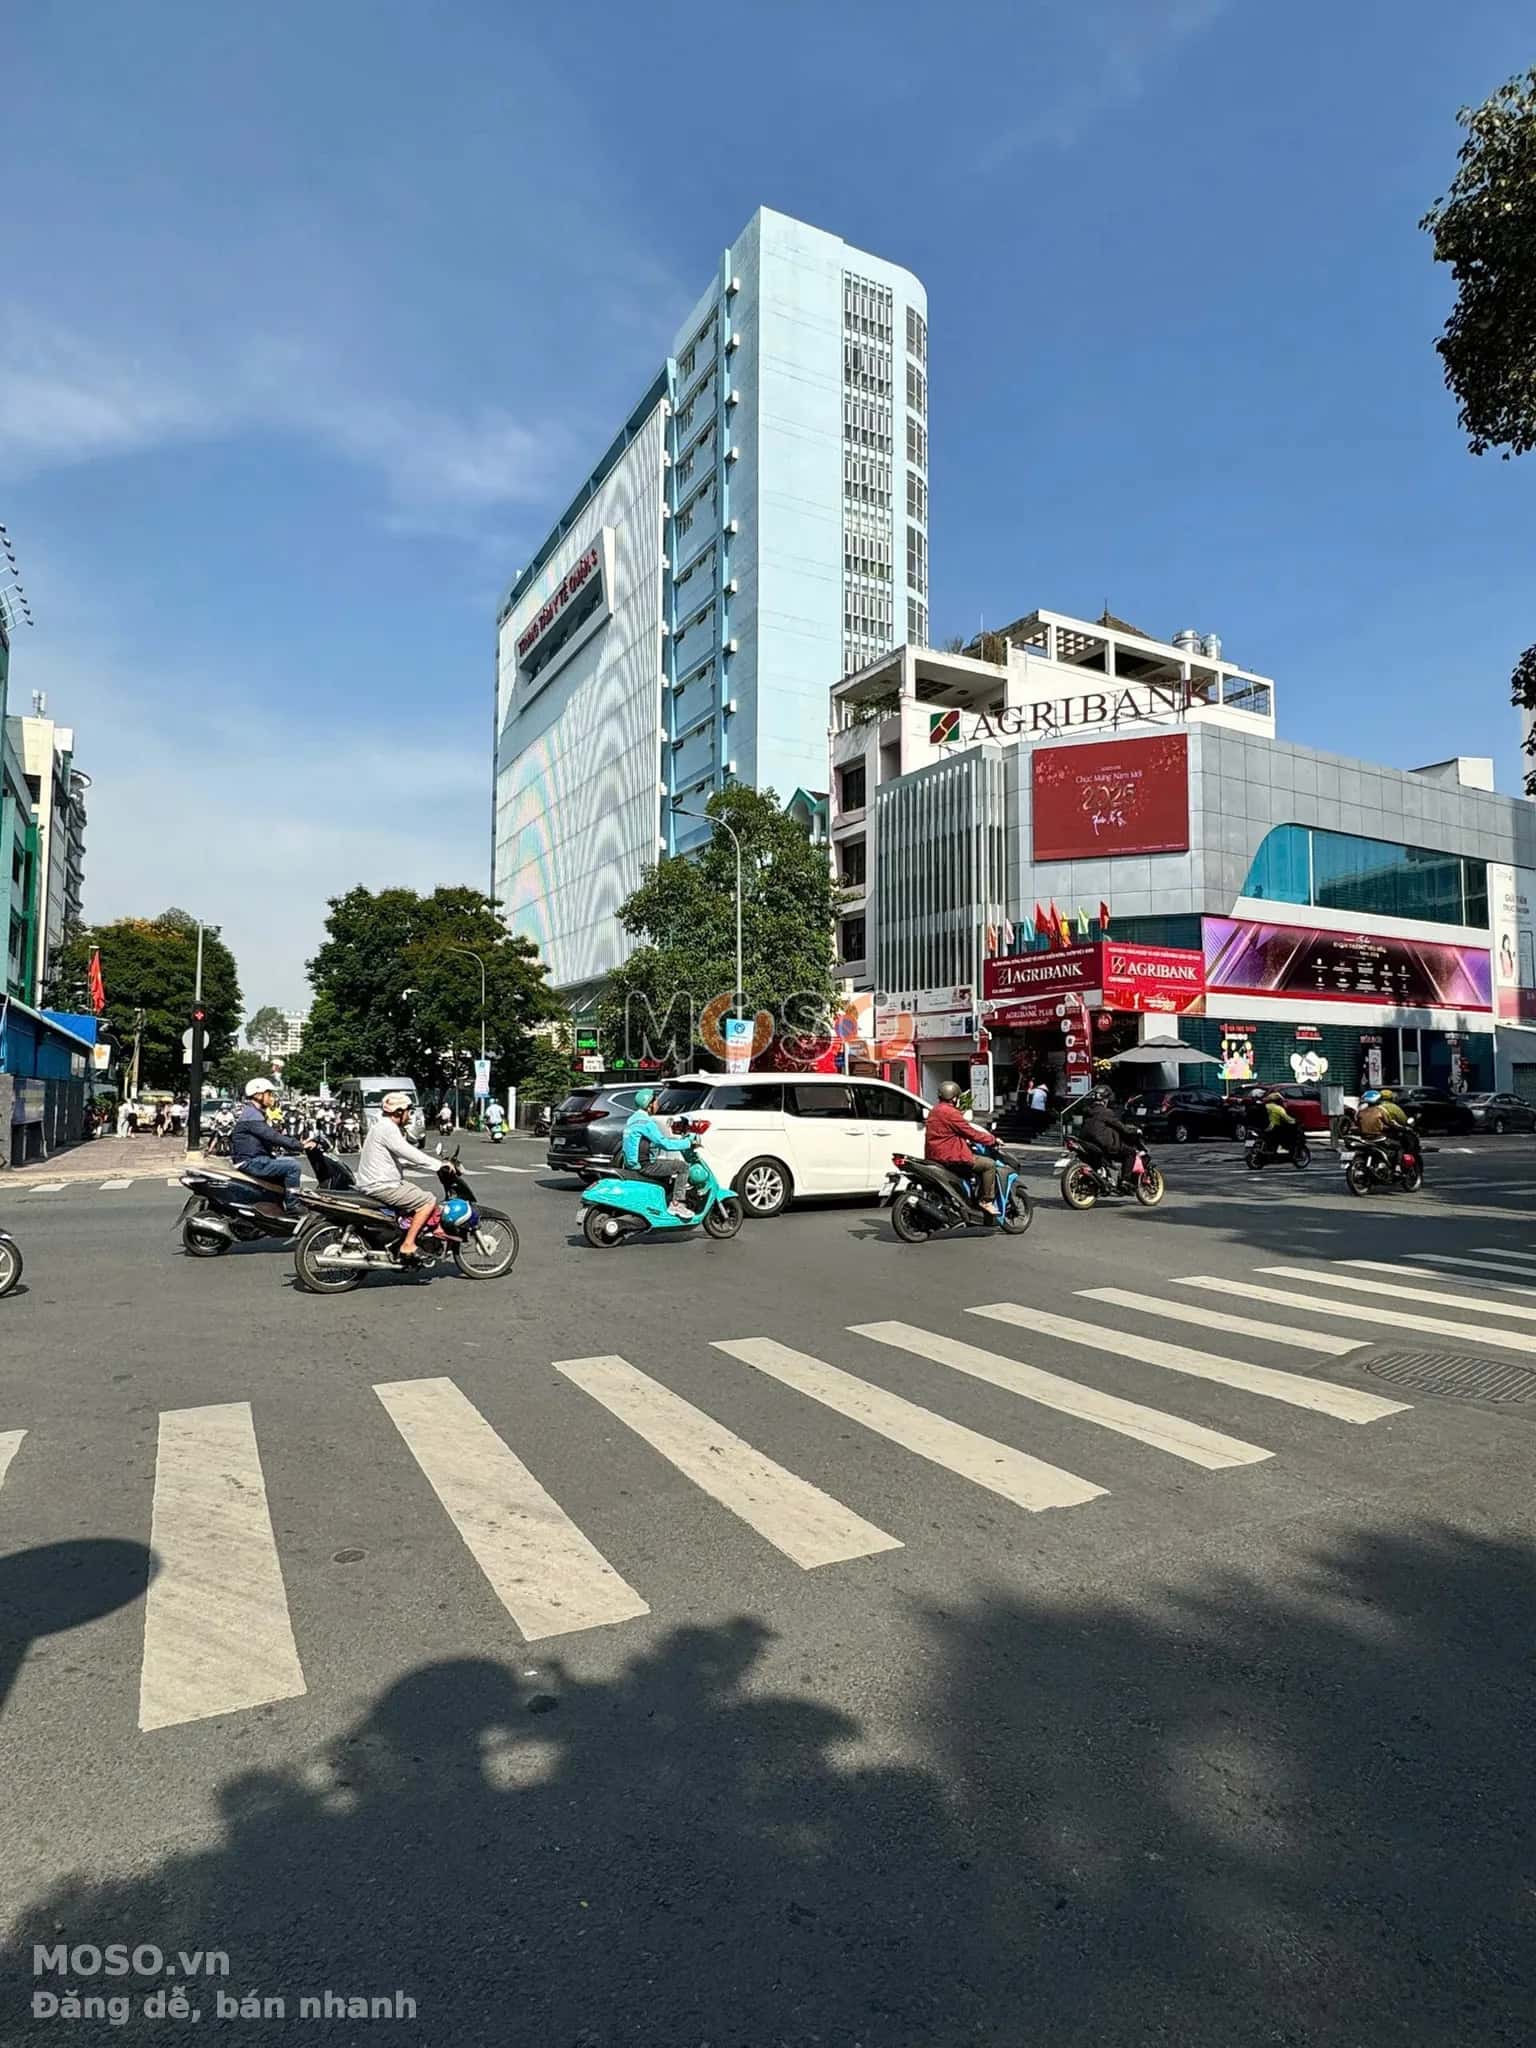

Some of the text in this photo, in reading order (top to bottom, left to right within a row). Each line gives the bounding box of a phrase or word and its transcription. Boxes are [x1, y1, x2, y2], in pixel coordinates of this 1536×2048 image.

[971, 684, 1211, 739] AGRIBANK
[1012, 962, 1084, 984] AGRIBANK
[1127, 961, 1198, 981] AGRIBANK
